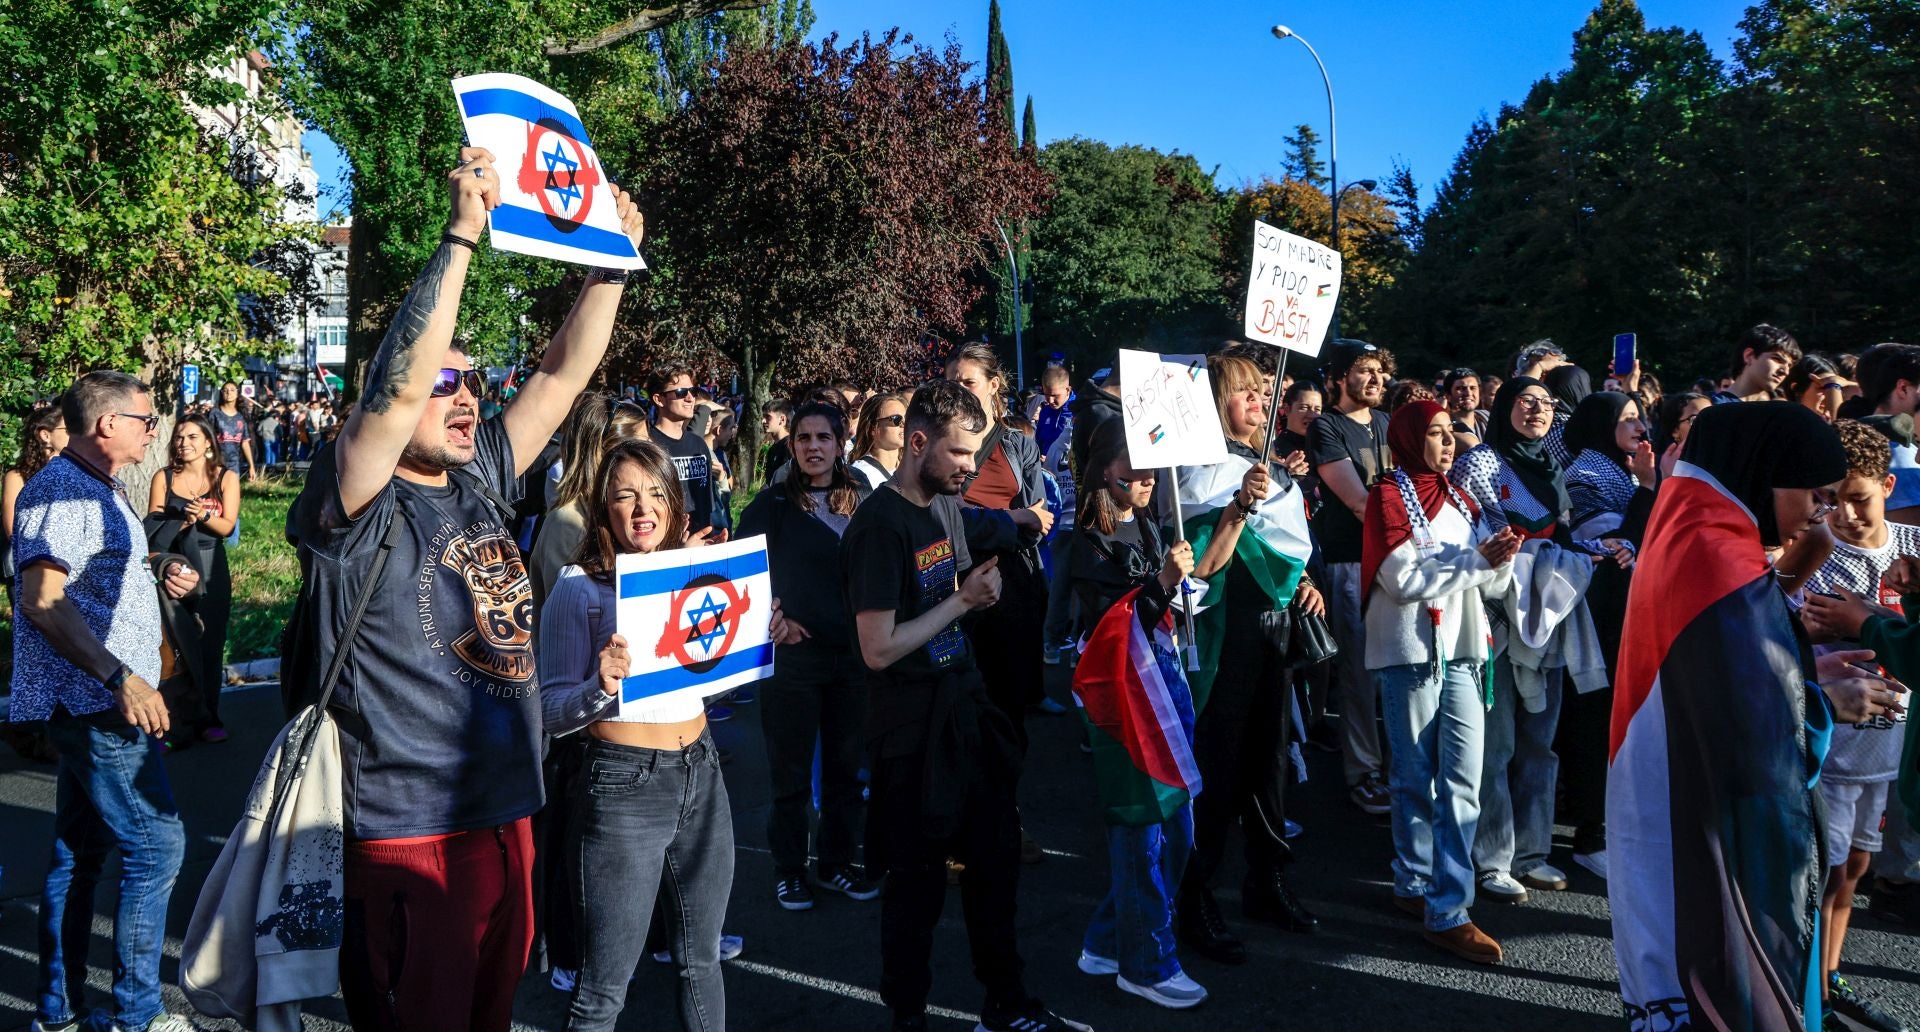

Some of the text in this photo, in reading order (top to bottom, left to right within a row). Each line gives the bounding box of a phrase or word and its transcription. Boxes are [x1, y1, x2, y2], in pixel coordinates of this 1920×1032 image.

[1288, 242, 1332, 270] MADRE
[1257, 261, 1308, 295] Y PIDO
[1286, 295, 1299, 309] YA
[1254, 299, 1310, 344] BASTA
[1124, 366, 1174, 427] BASTA
[1160, 381, 1199, 438] YA!
[518, 584, 531, 595] WES
[418, 594, 438, 640] TRUNK
[431, 638, 443, 649] A
[450, 666, 482, 688] JOY
[485, 683, 521, 699] RIDE
